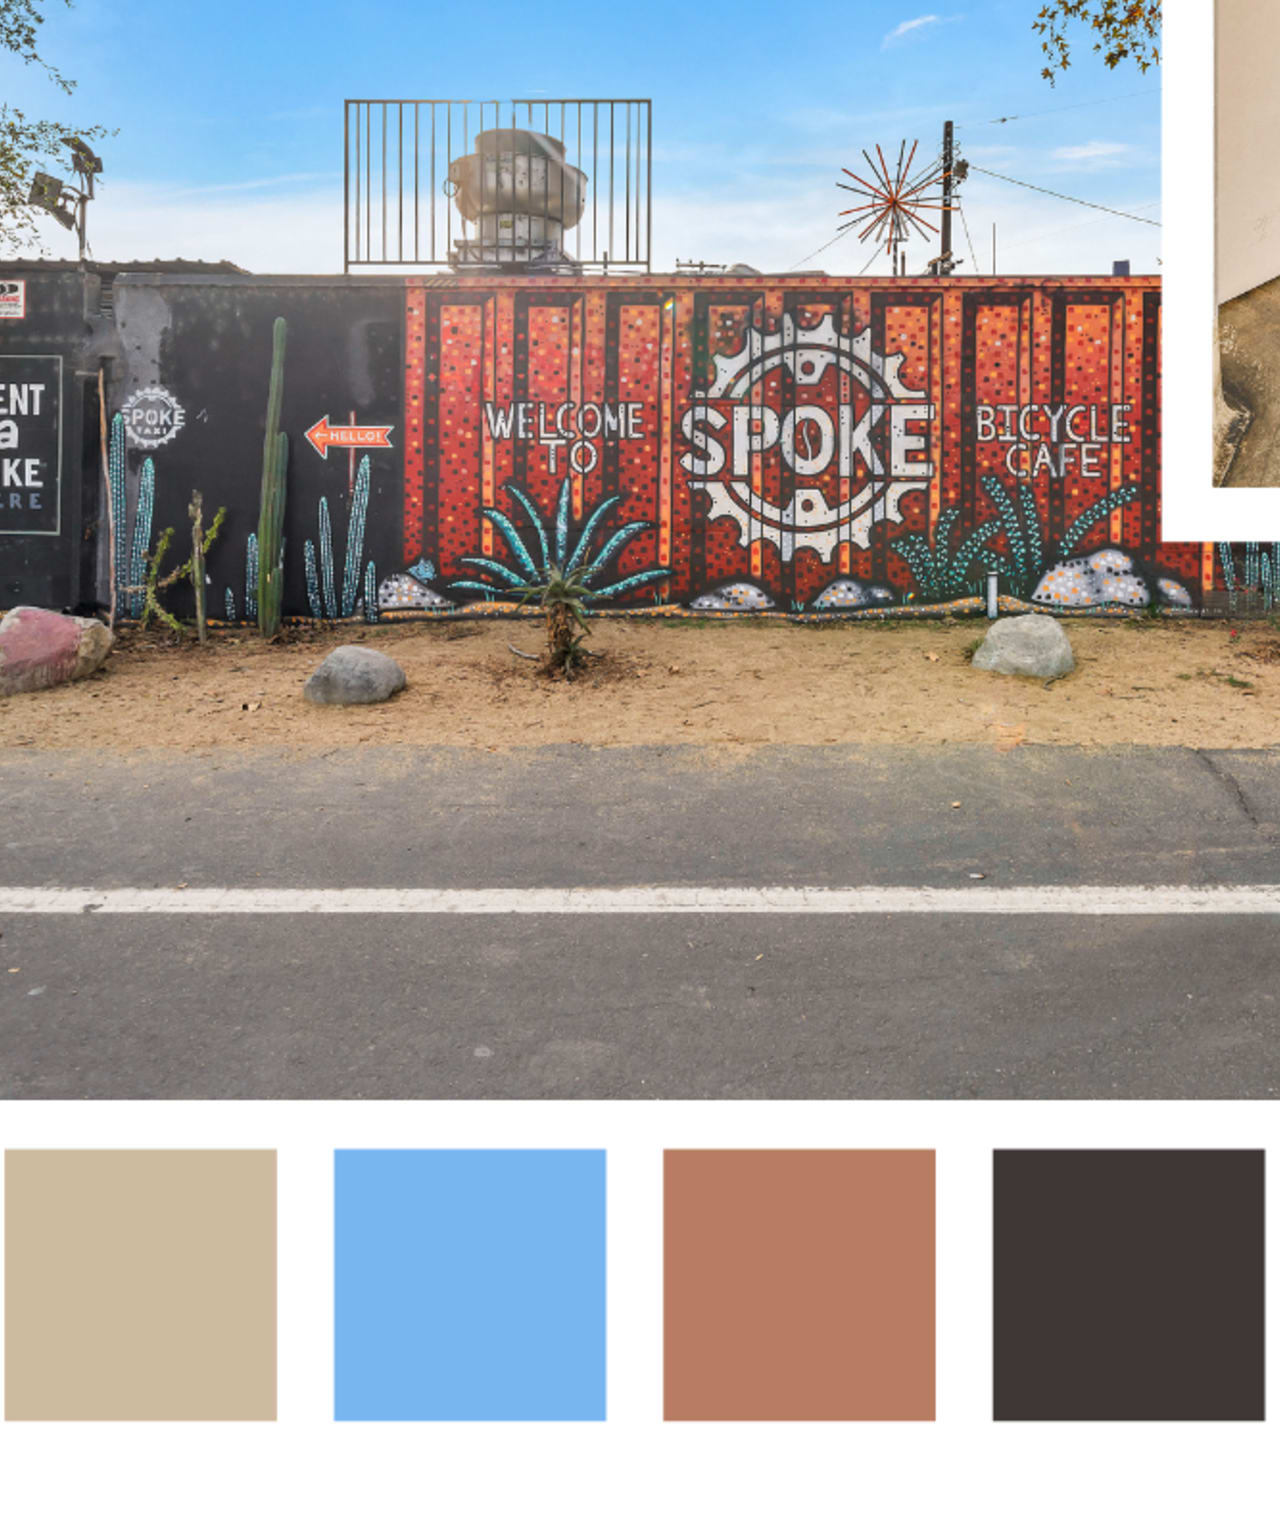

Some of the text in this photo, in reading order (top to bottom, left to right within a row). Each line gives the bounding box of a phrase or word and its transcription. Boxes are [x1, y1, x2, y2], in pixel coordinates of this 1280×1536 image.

[122, 410, 186, 427] SPOKE
[137, 426, 168, 436] TAXI
[329, 430, 383, 442] HELLO!
[485, 401, 646, 441] WELCOME
[974, 403, 1133, 443] BICYCLE
[539, 438, 599, 475] TO
[679, 402, 936, 479] SPOKE
[1005, 442, 1102, 479] CAFE
